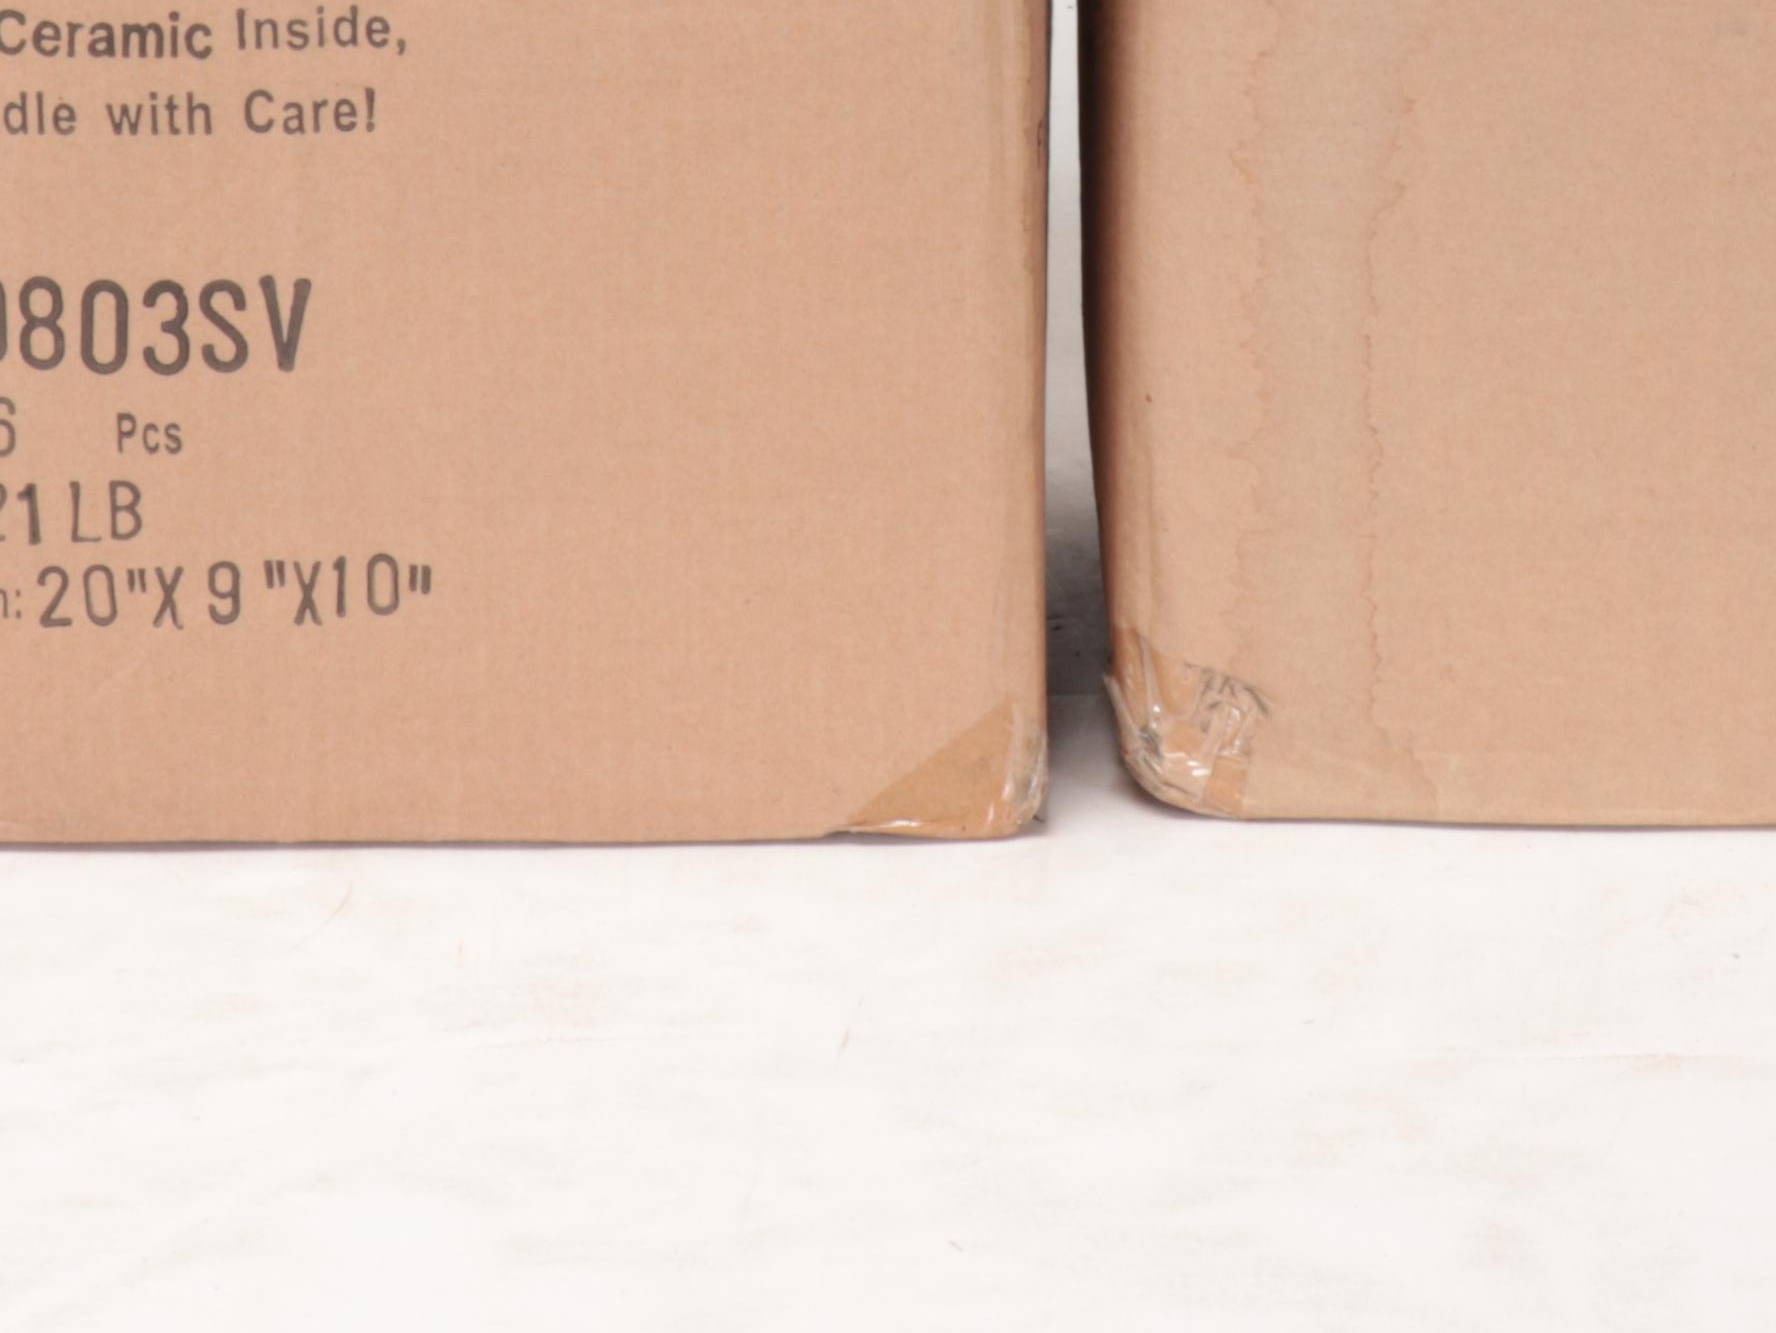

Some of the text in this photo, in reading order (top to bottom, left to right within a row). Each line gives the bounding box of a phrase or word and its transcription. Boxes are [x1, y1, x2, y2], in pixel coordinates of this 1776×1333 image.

[235, 4, 407, 56] Inside,
[105, 91, 213, 136] with
[243, 86, 376, 135] Care!
[116, 412, 183, 455] Pcs
[68, 479, 143, 544] LB
